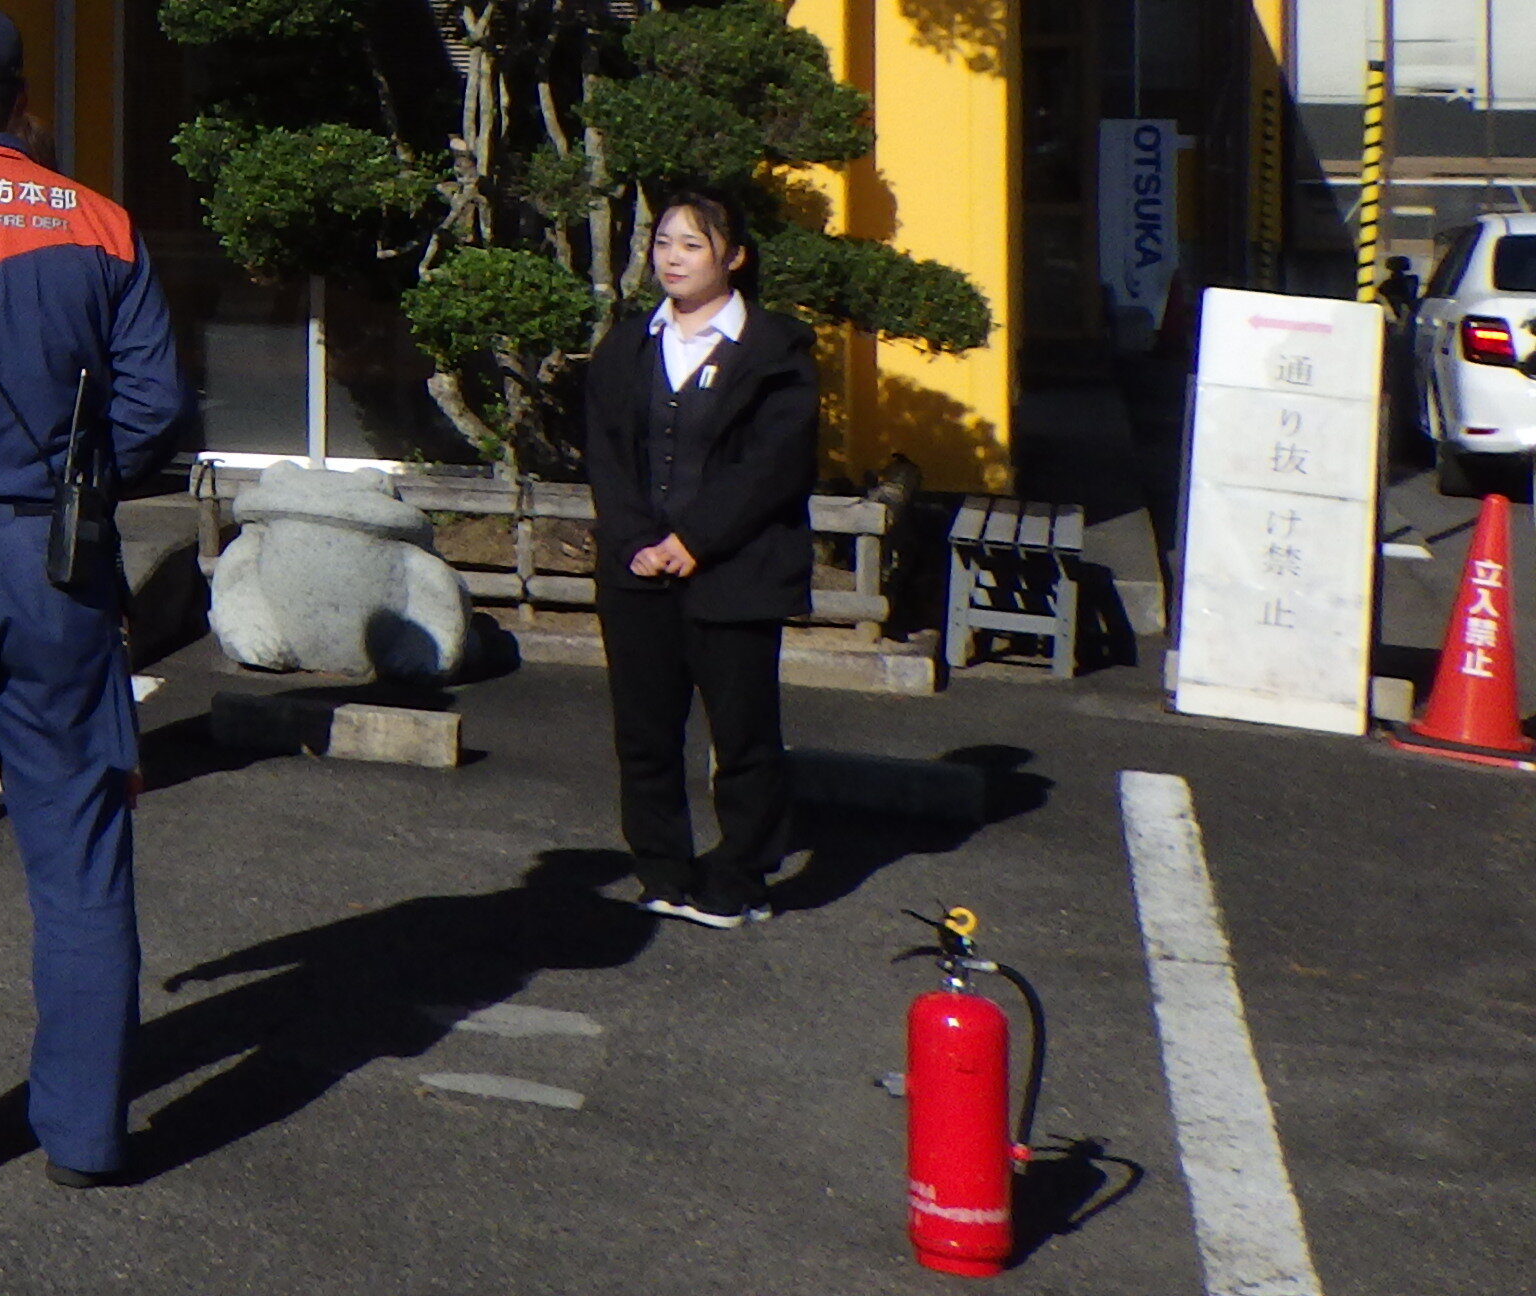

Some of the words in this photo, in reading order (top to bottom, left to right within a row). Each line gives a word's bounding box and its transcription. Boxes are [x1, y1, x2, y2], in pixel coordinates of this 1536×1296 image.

[1133, 124, 1162, 268] OTSUKA
[1257, 354, 1314, 630] 通り抜け禁止
[1460, 559, 1503, 678] 立入禁止
